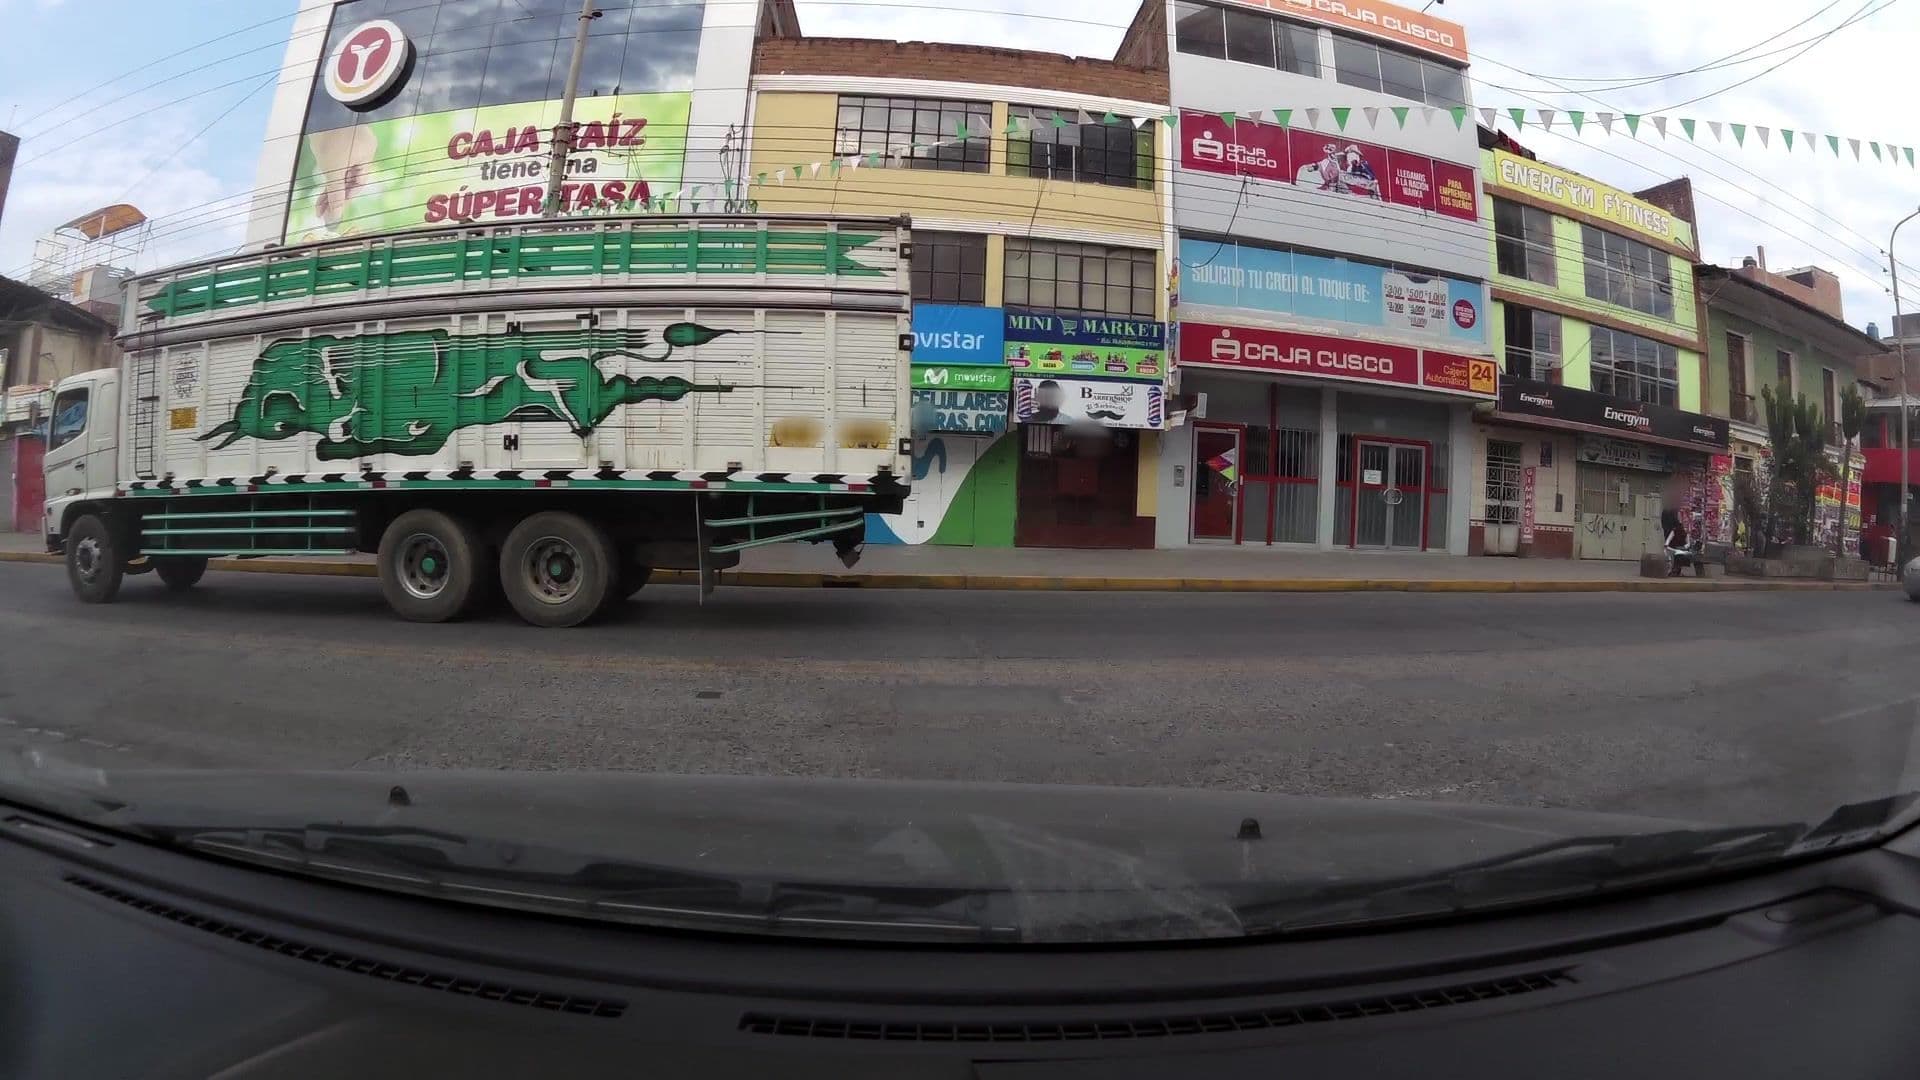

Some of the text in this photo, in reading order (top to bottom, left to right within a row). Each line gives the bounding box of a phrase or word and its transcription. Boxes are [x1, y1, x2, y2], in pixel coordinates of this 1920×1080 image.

[1315, 0, 1454, 48] CAJA CUSCO
[447, 124, 540, 160] CAJA
[1226, 143, 1266, 158] CAJA
[480, 160, 543, 181] tiene
[1226, 152, 1277, 169] CUSCO
[424, 180, 651, 223] SÚPER TASA
[1191, 263, 1245, 288] SOLICITA
[1247, 270, 1263, 289] TU
[1317, 278, 1351, 301] TOQUE
[1007, 314, 1163, 338] MINI MARKET
[1244, 342, 1394, 374] CAJA CUSCO
[954, 373, 996, 383] movistar
[1471, 364, 1492, 382] 24
[1520, 392, 1553, 406] Energym
[1604, 406, 1649, 427] Energym
